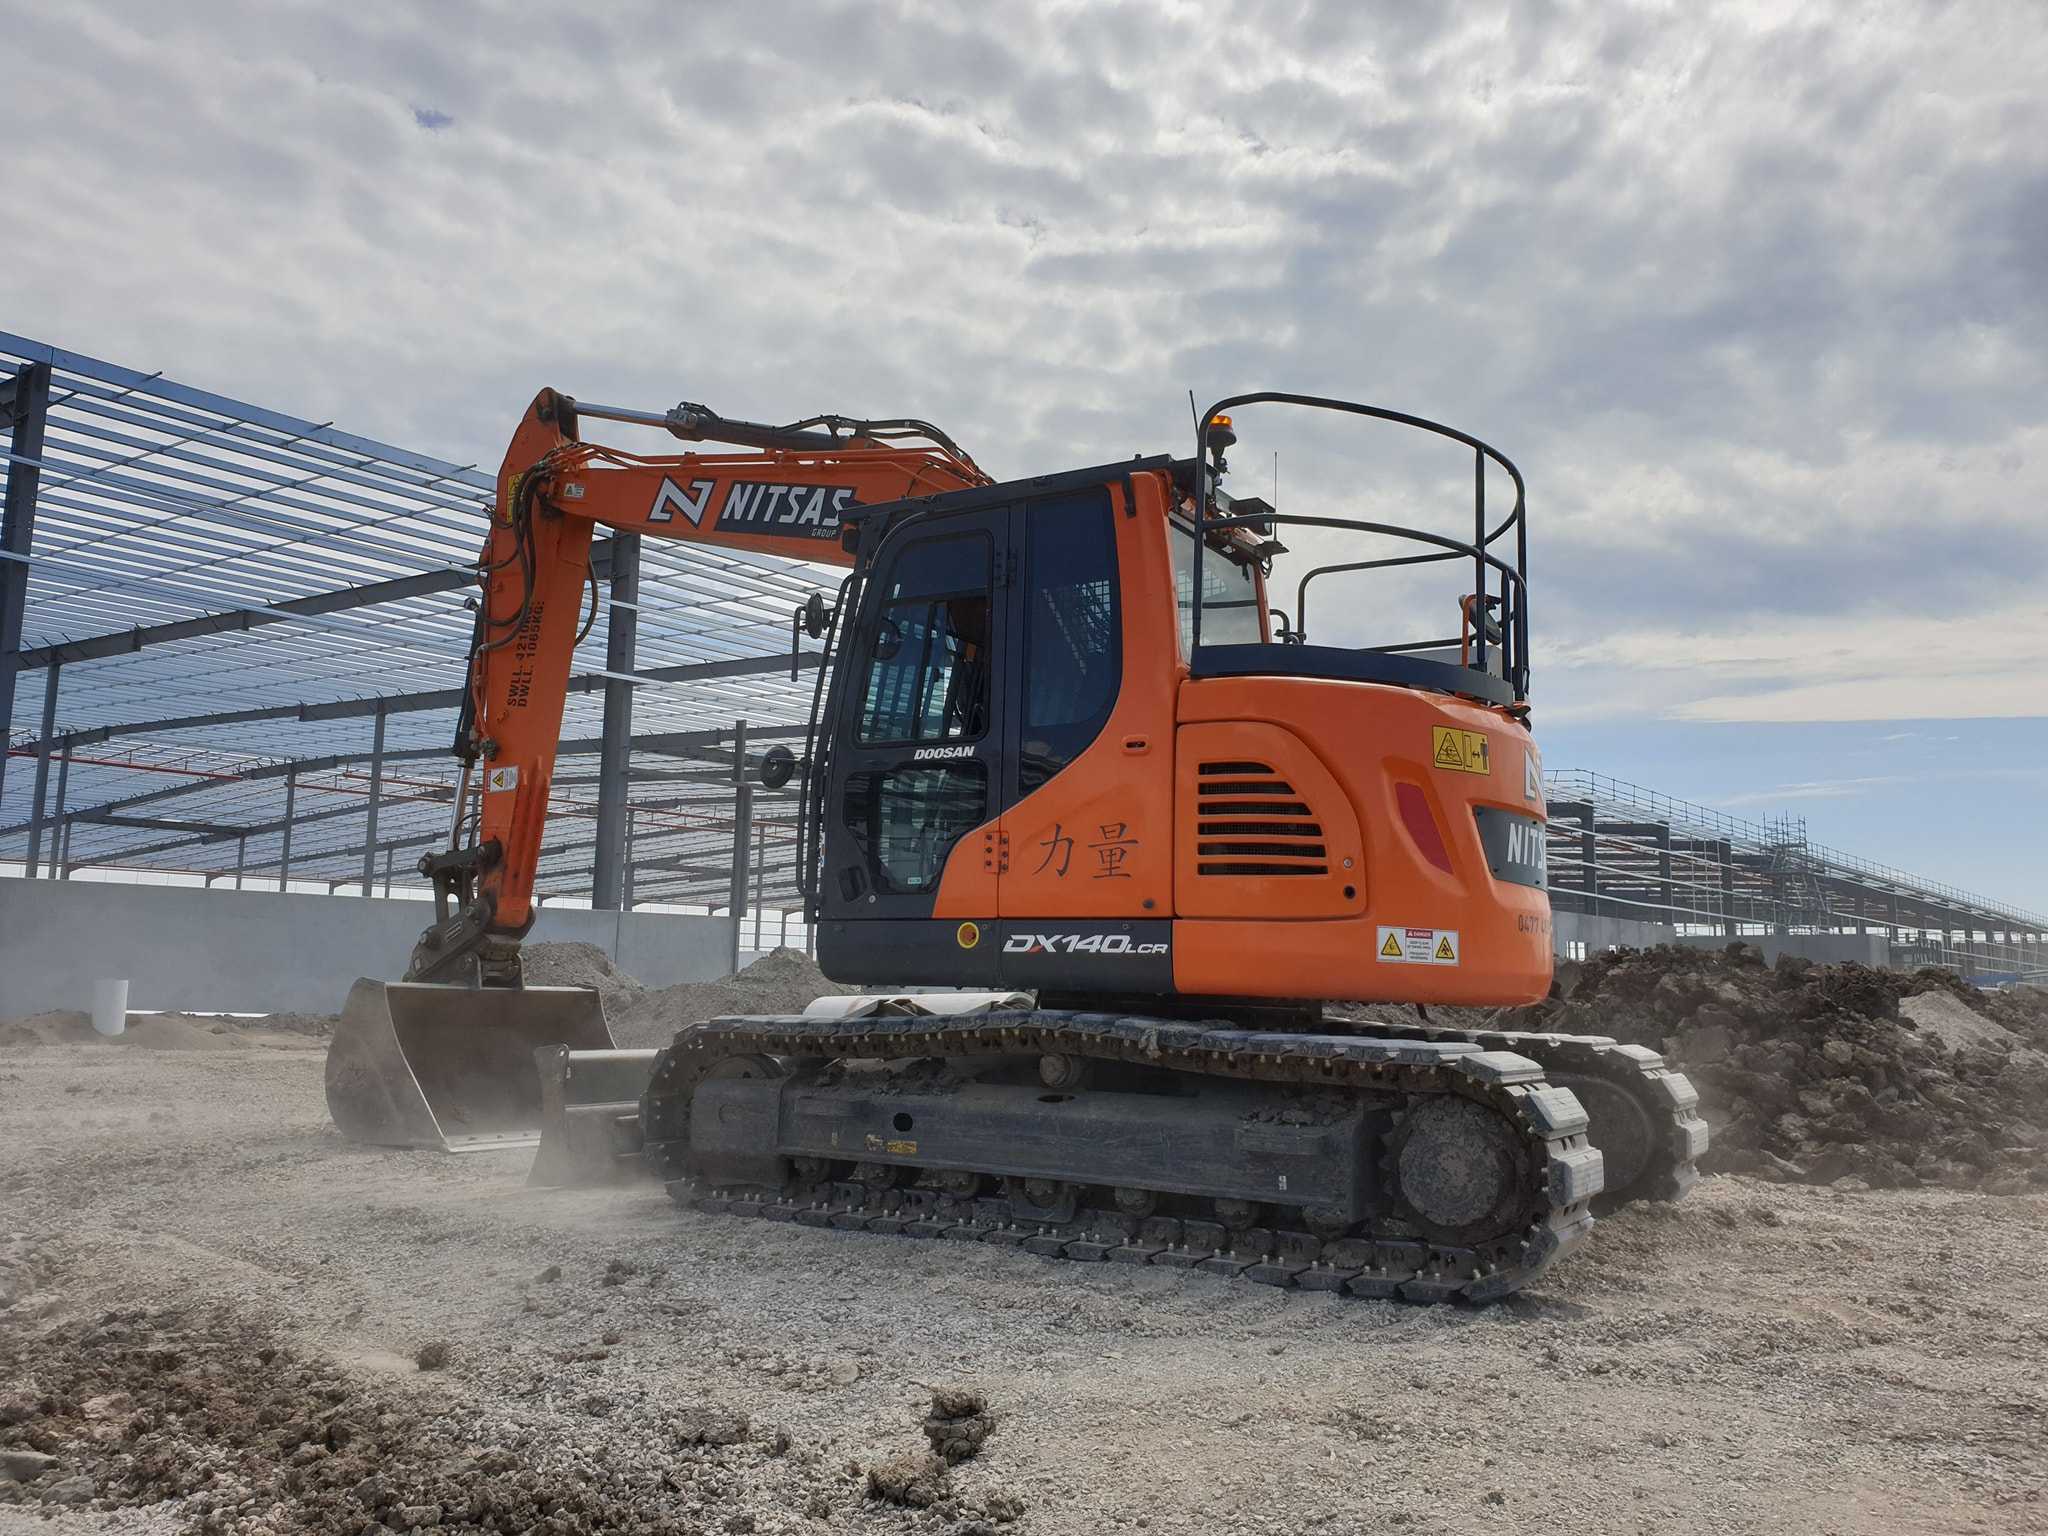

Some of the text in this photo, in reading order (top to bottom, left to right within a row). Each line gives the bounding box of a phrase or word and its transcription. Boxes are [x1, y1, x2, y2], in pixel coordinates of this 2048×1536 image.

[721, 482, 853, 527] NITSAS
[811, 527, 838, 538] GROUP
[913, 745, 975, 760] DOOSAN
[1032, 822, 1138, 879] 力量
